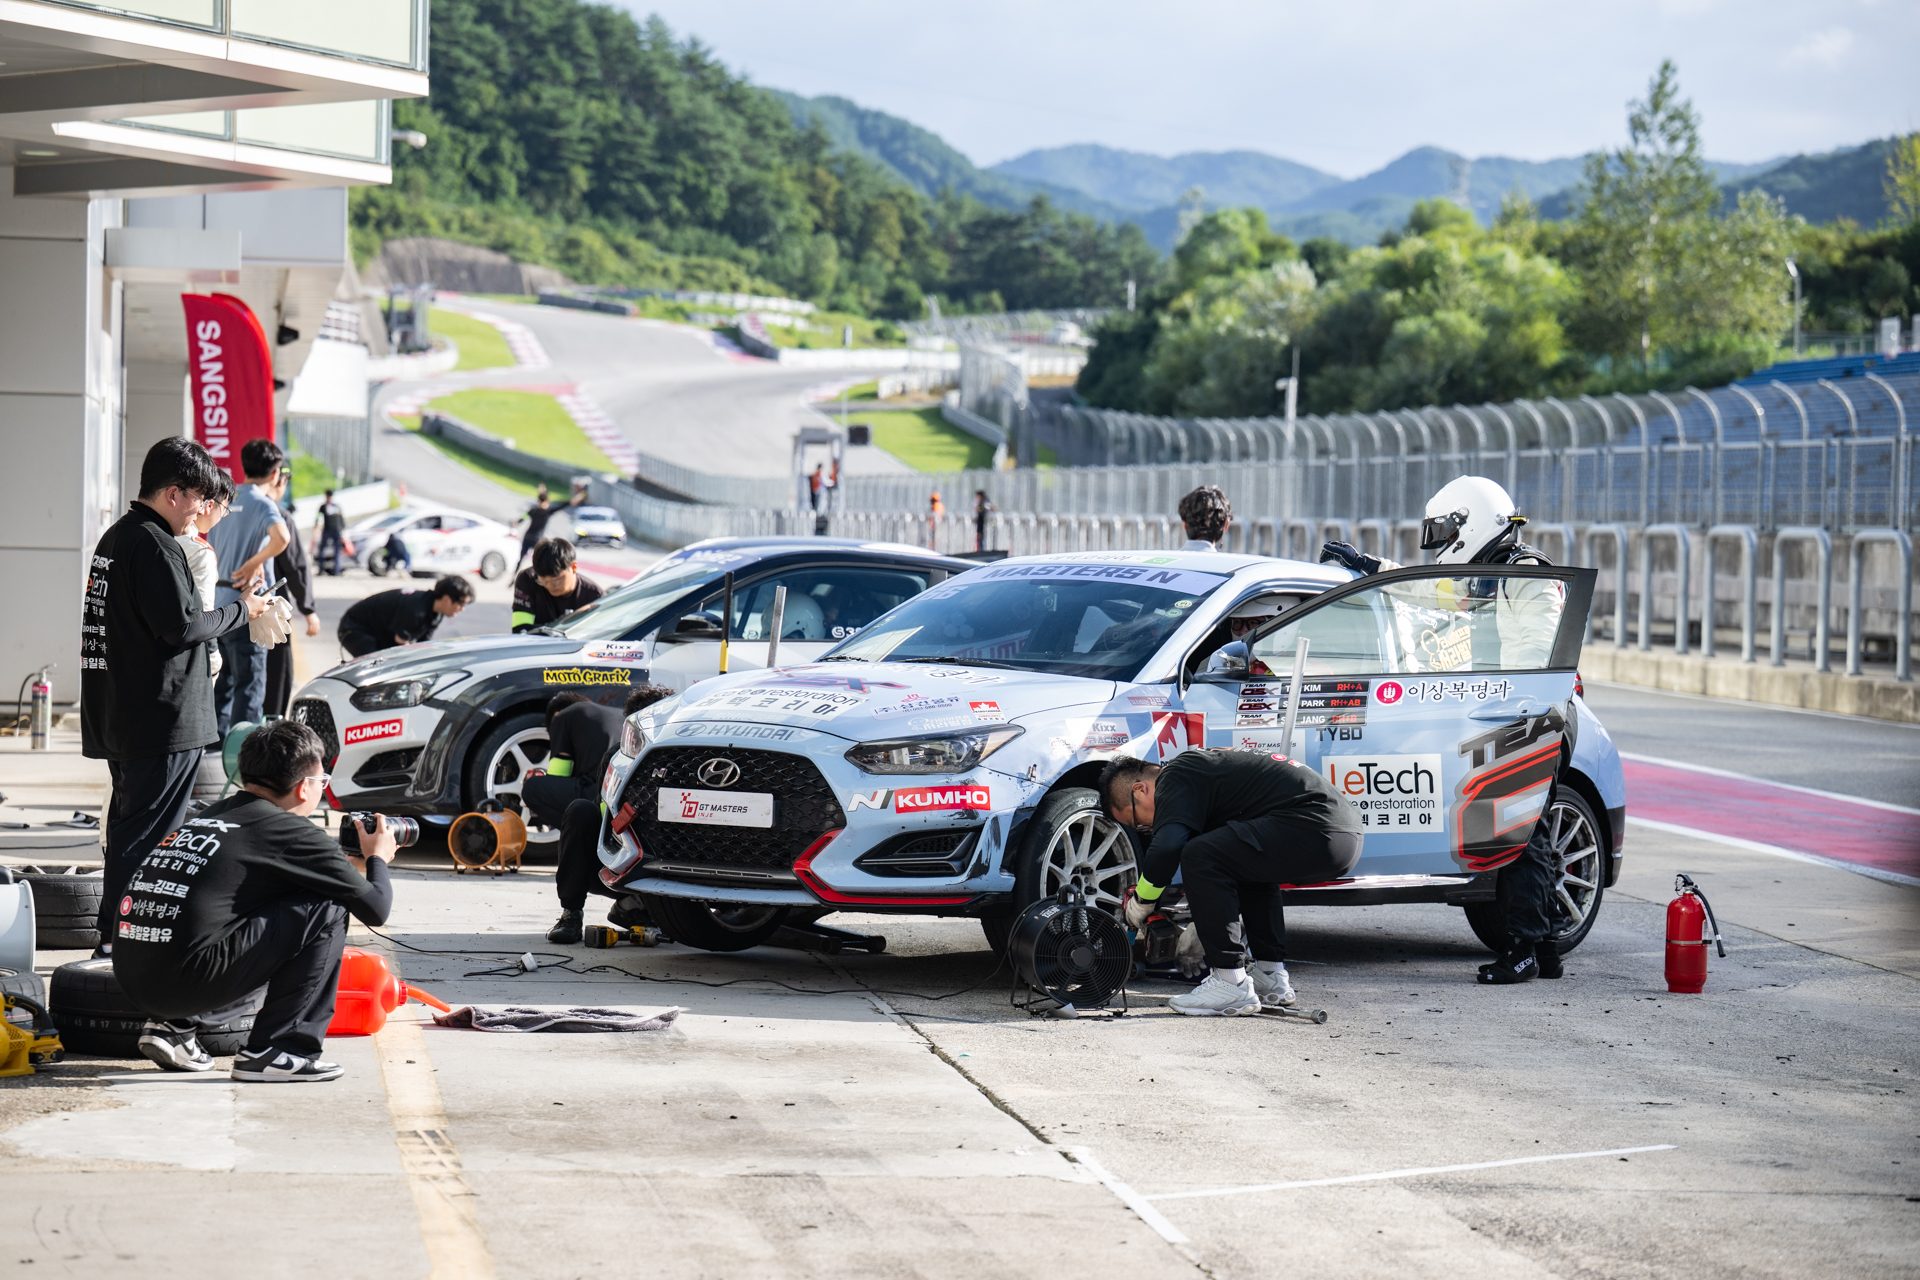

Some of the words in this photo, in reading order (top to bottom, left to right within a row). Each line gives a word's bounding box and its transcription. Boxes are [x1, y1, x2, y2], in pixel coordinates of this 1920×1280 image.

[196, 320, 231, 458] SANGSIN
[985, 565, 1141, 580] MASTERS
[1146, 570, 1180, 585] N
[544, 669, 580, 684] MOTO
[1303, 684, 1322, 692] KIM
[1336, 683, 1363, 691] RH+A
[1408, 680, 1512, 701] 이상복명과
[1301, 699, 1325, 708] PARK
[1330, 698, 1361, 707] RH+AB
[1092, 721, 1116, 732] Kixx
[1300, 715, 1326, 724] JANG
[347, 721, 402, 742] KUMHO
[708, 724, 796, 741] HYUNDAI
[897, 790, 989, 808] KUMHO
[1370, 797, 1435, 810] restoration
[699, 803, 710, 811] GT
[710, 804, 749, 814] MASTERS
[158, 828, 222, 857] eTech
